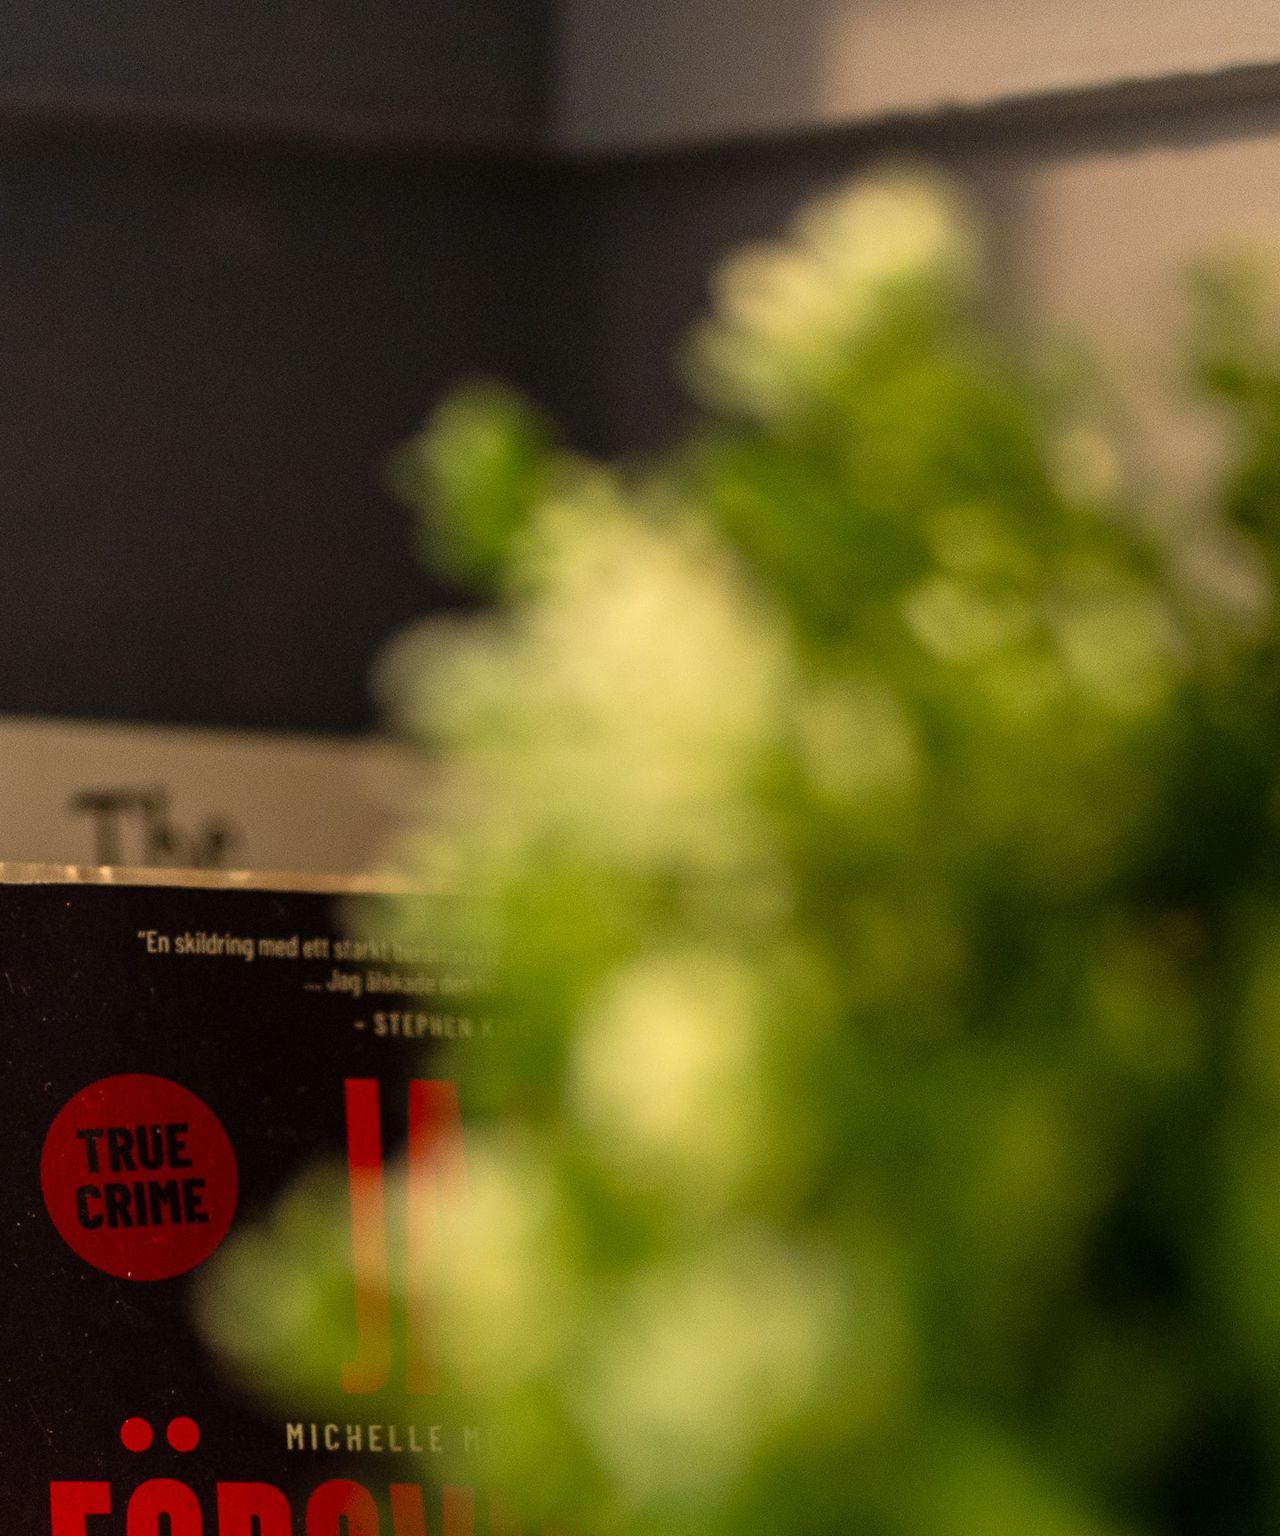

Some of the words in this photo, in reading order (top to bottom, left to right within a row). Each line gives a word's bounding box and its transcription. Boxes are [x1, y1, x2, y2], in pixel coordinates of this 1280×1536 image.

[174, 931, 255, 963] skildring
[258, 935, 298, 958] med
[303, 937, 329, 960] ett
[327, 968, 363, 998] Jag
[373, 1010, 474, 1039] STEPHEN
[75, 1122, 192, 1174] TRUE
[75, 1178, 209, 1231] CRIME
[340, 1076, 472, 1395] JA
[286, 1422, 444, 1453] MICHELLE
